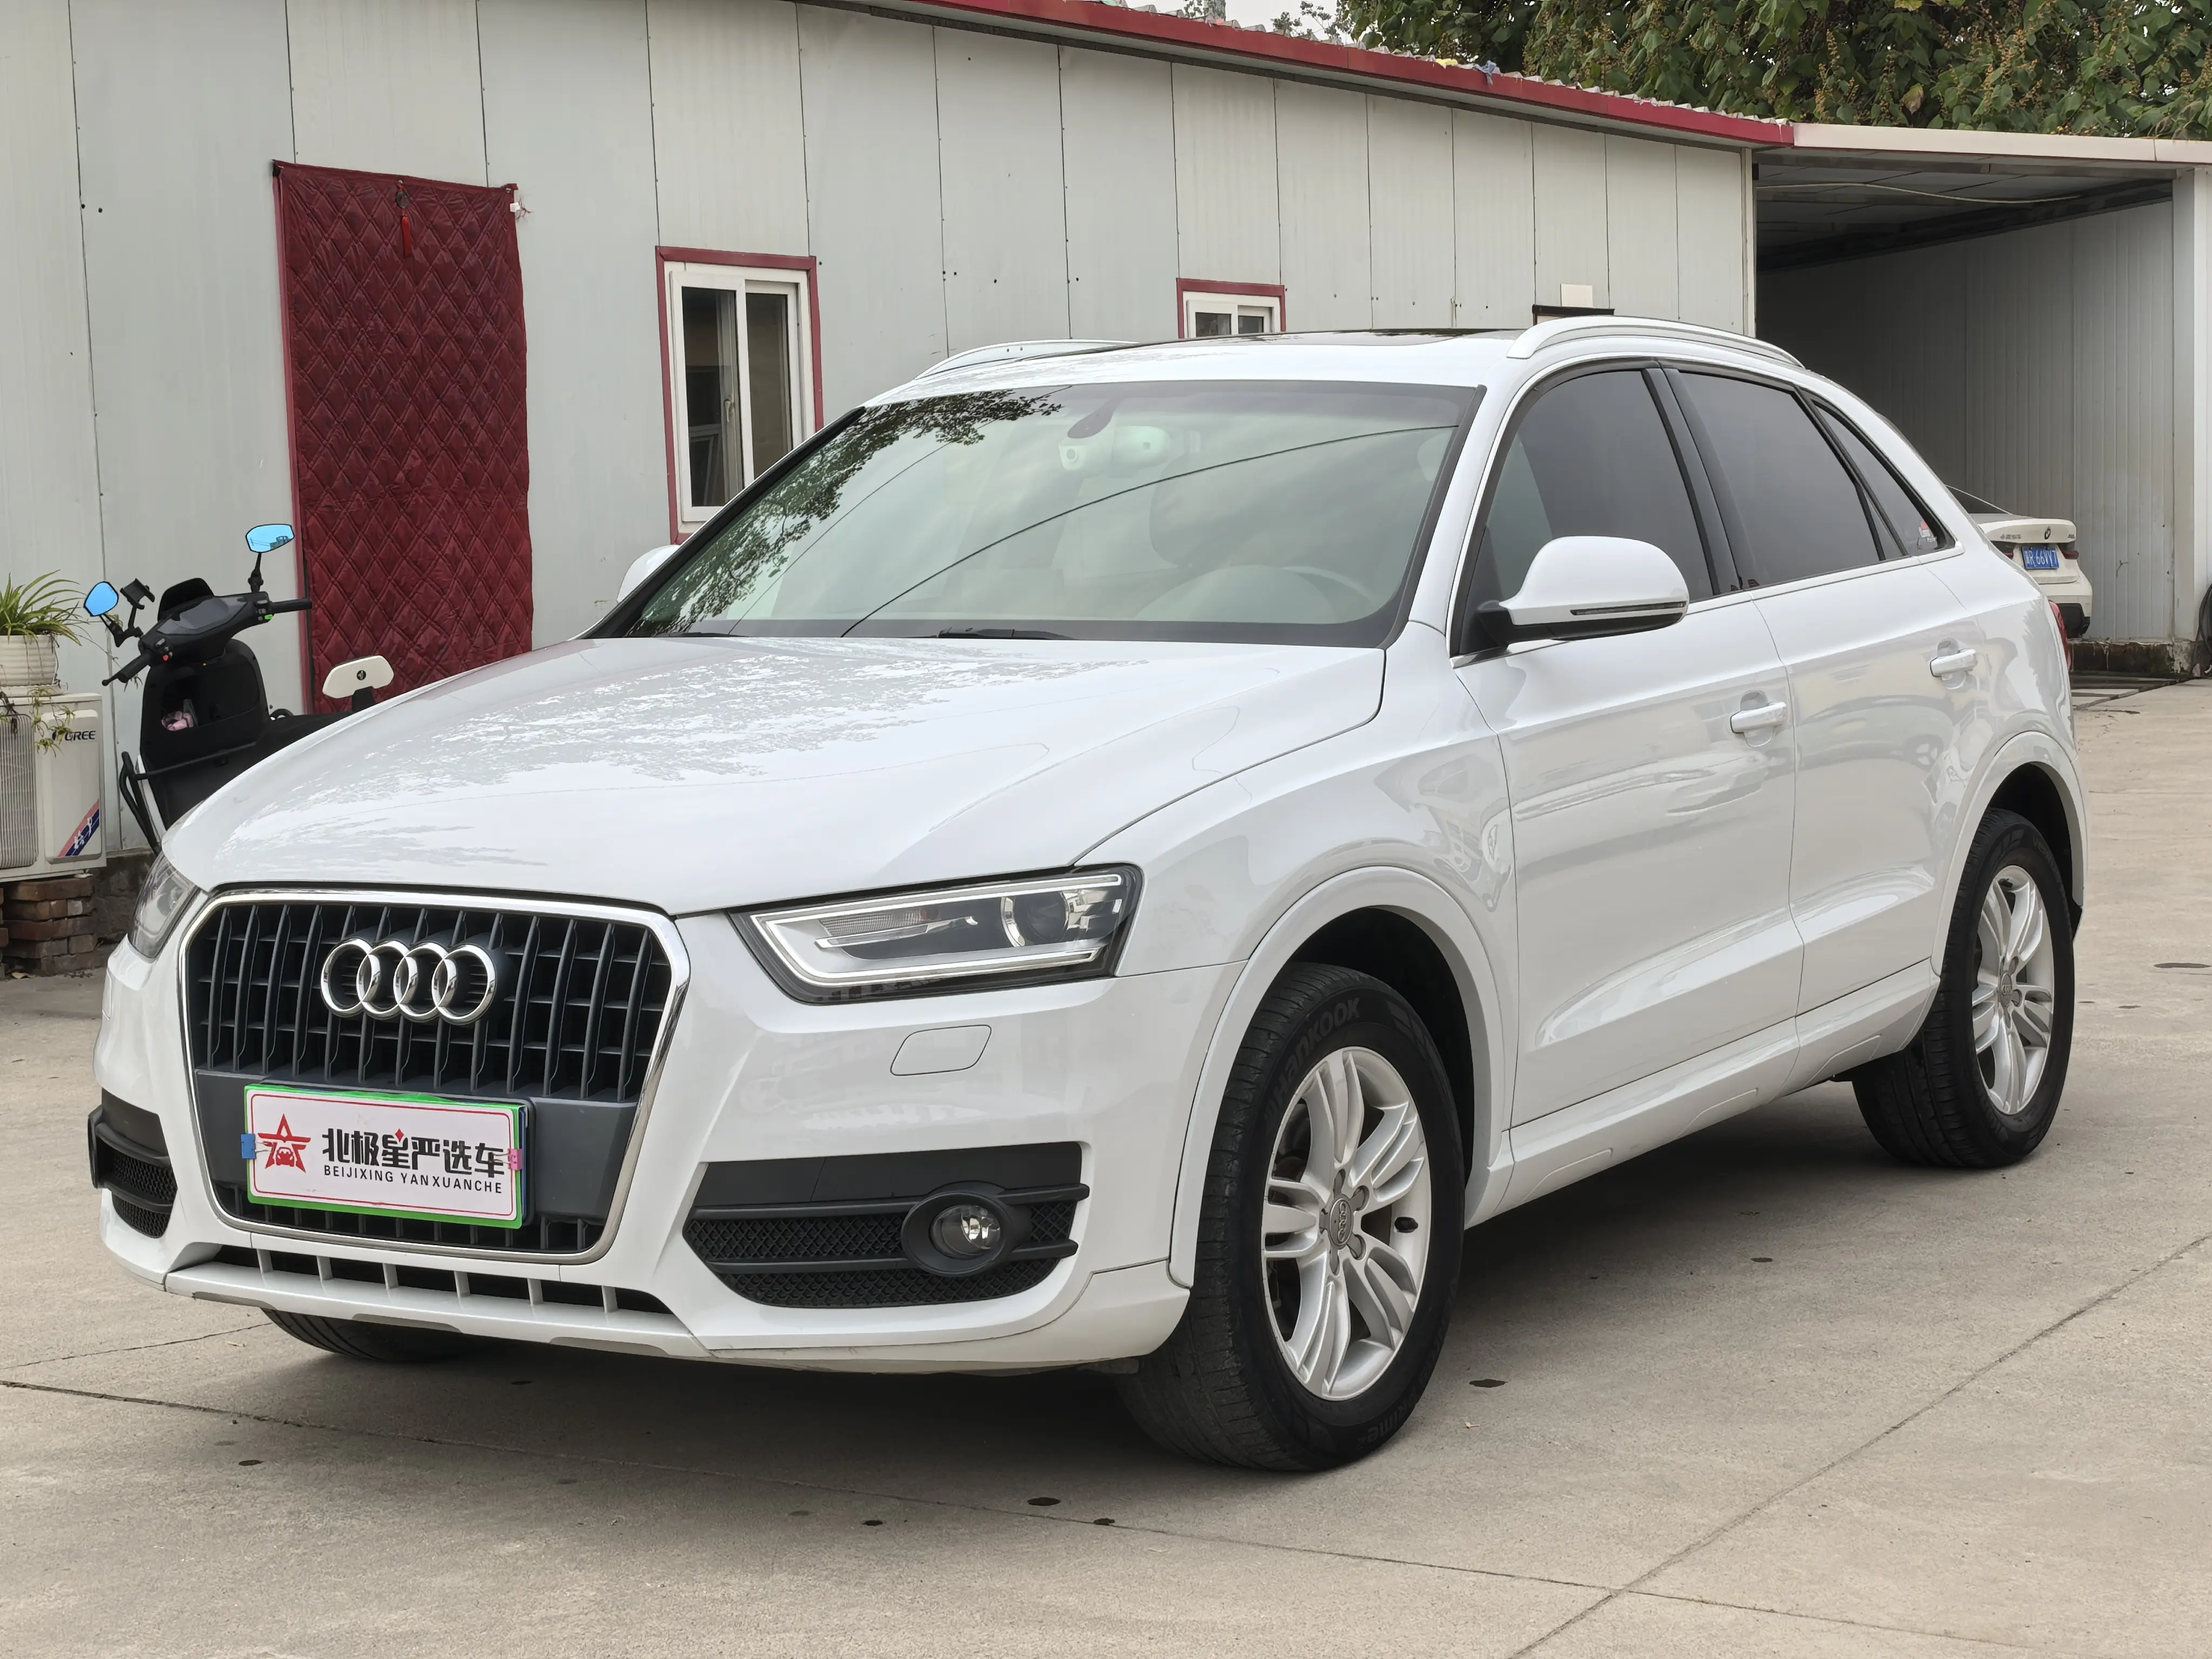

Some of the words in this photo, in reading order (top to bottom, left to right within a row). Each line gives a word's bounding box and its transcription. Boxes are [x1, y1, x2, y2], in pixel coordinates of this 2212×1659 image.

[64, 730, 96, 741] GREE
[322, 1128, 504, 1178] 北极星严选车
[325, 1165, 393, 1183] BEIJIXING
[401, 1172, 502, 1194] YANXUANCHE
